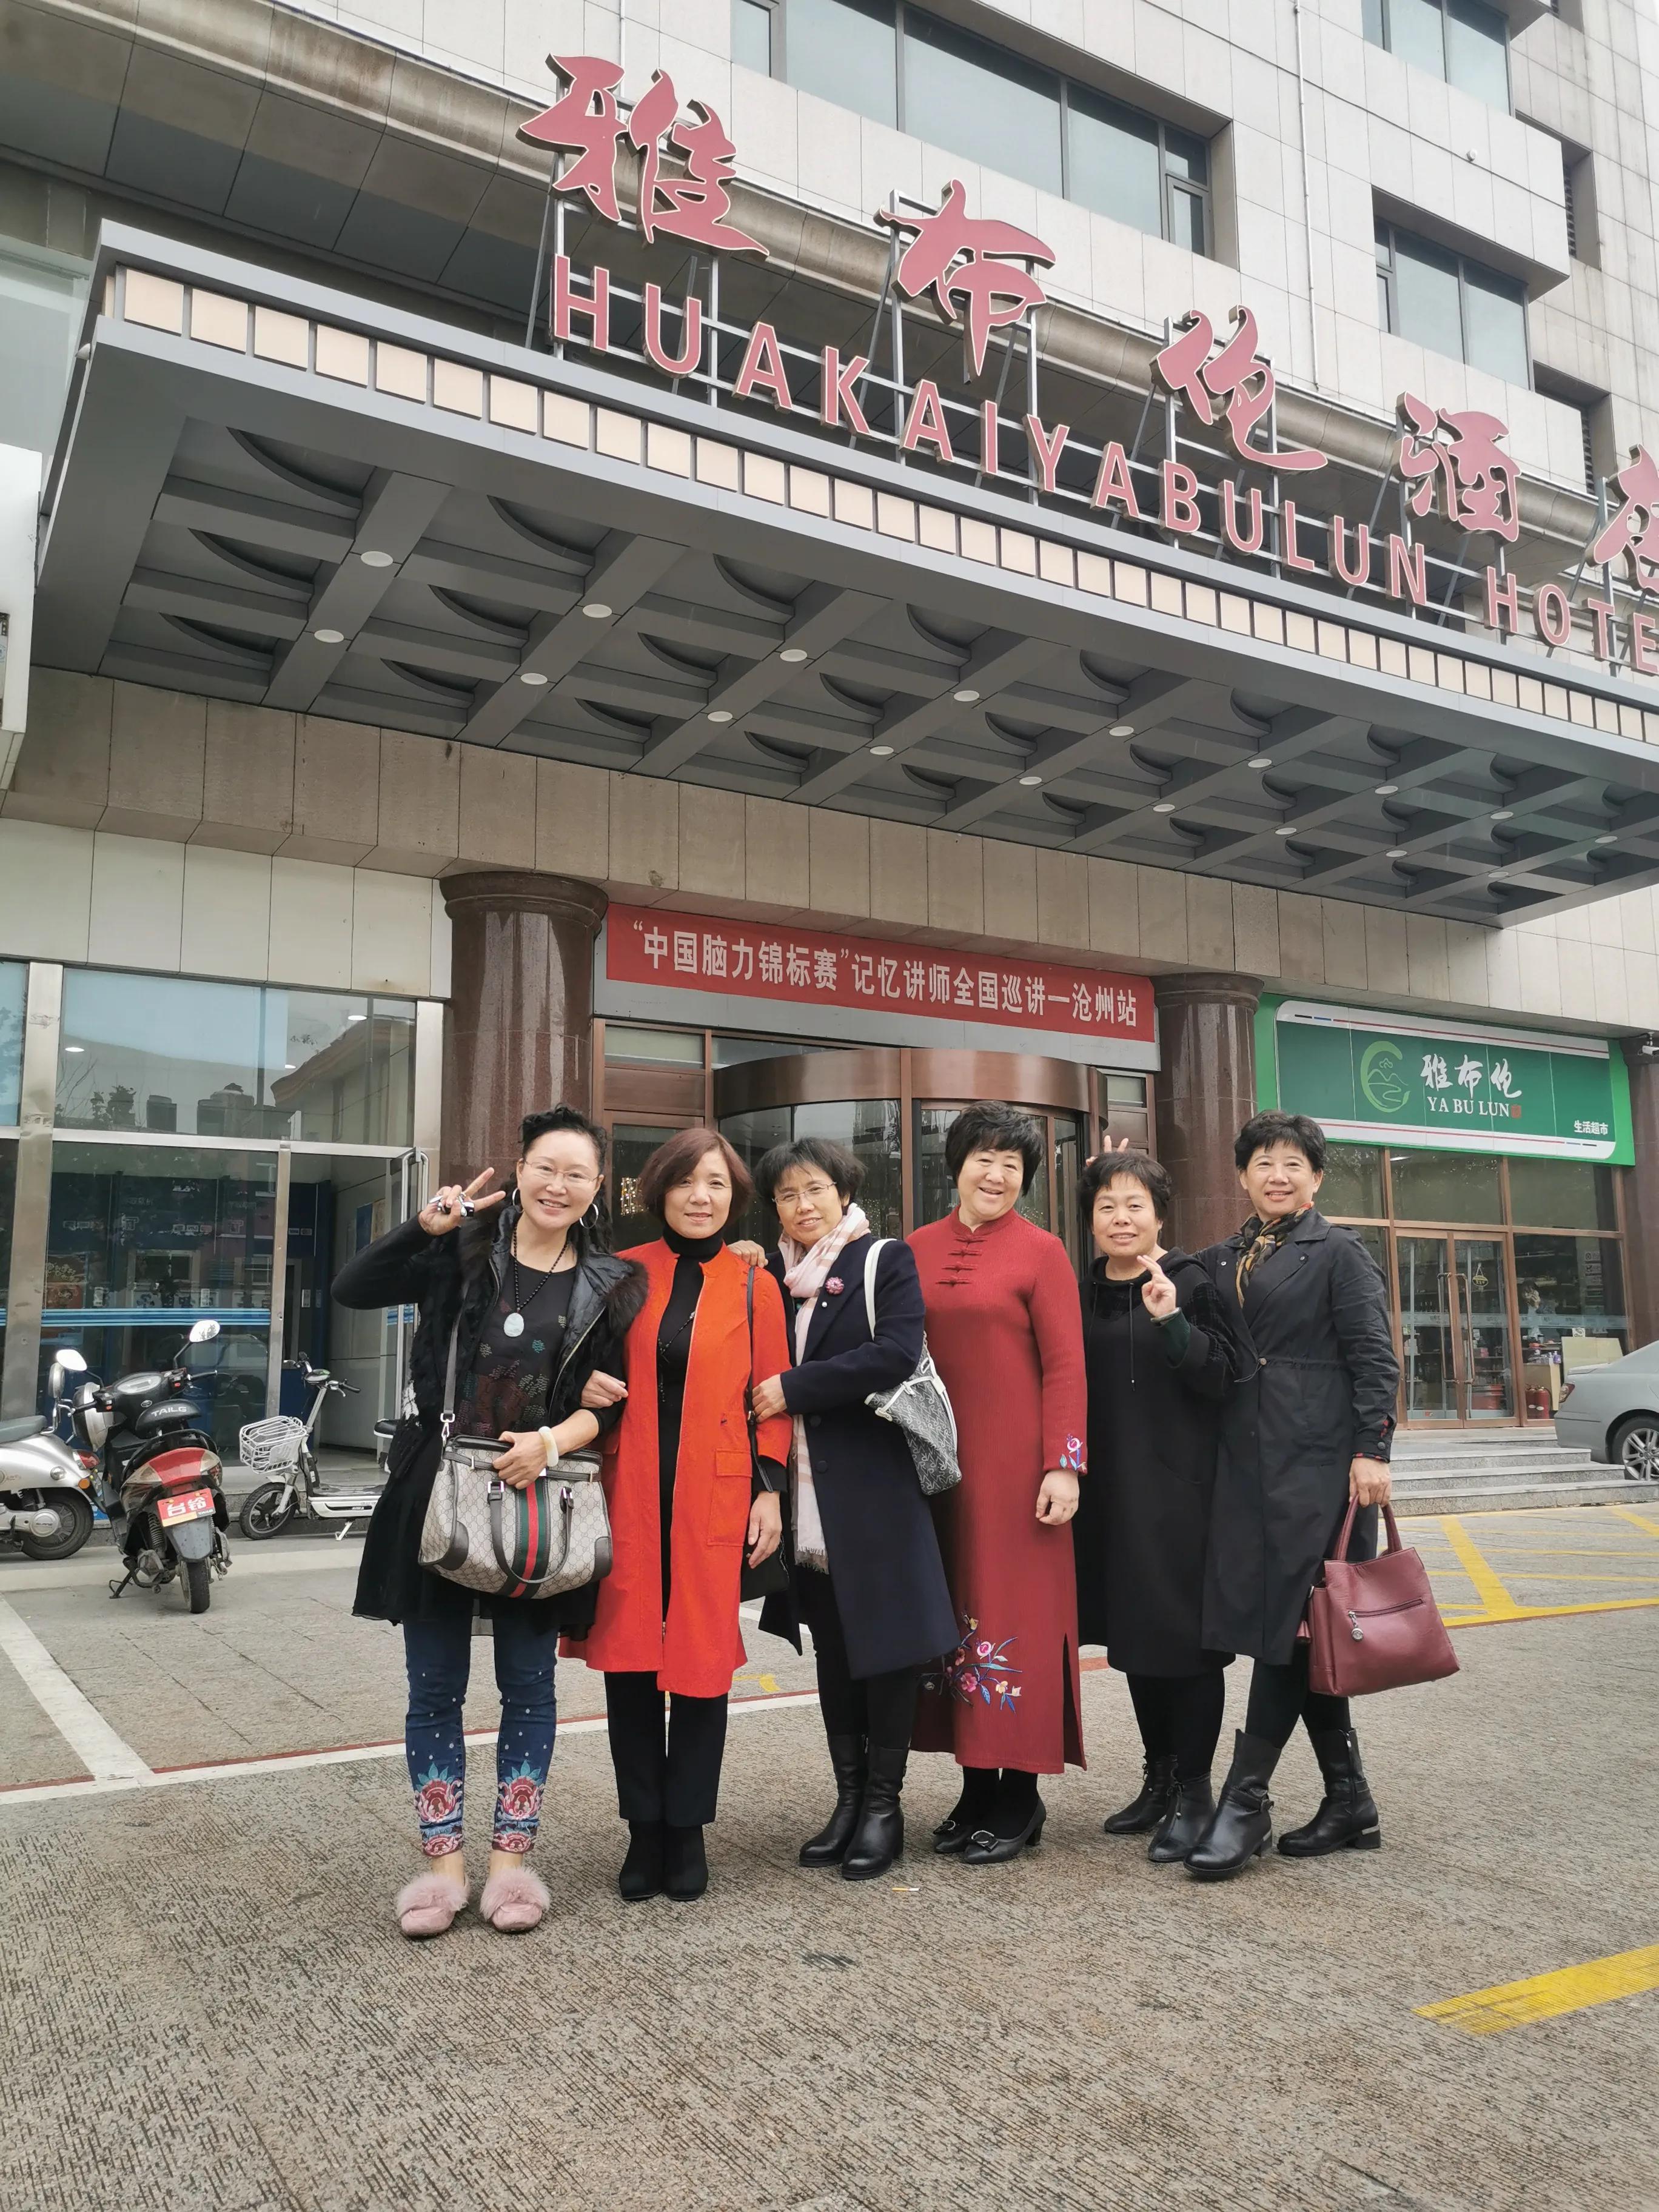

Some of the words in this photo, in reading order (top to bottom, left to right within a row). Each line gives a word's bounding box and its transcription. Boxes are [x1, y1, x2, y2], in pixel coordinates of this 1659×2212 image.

[1420, 1053, 1523, 1099] 雅布伦
[1574, 1119, 1609, 1136] 生活超市
[150, 1406, 187, 1417] TAILG
[167, 1496, 207, 1517] 台铃
